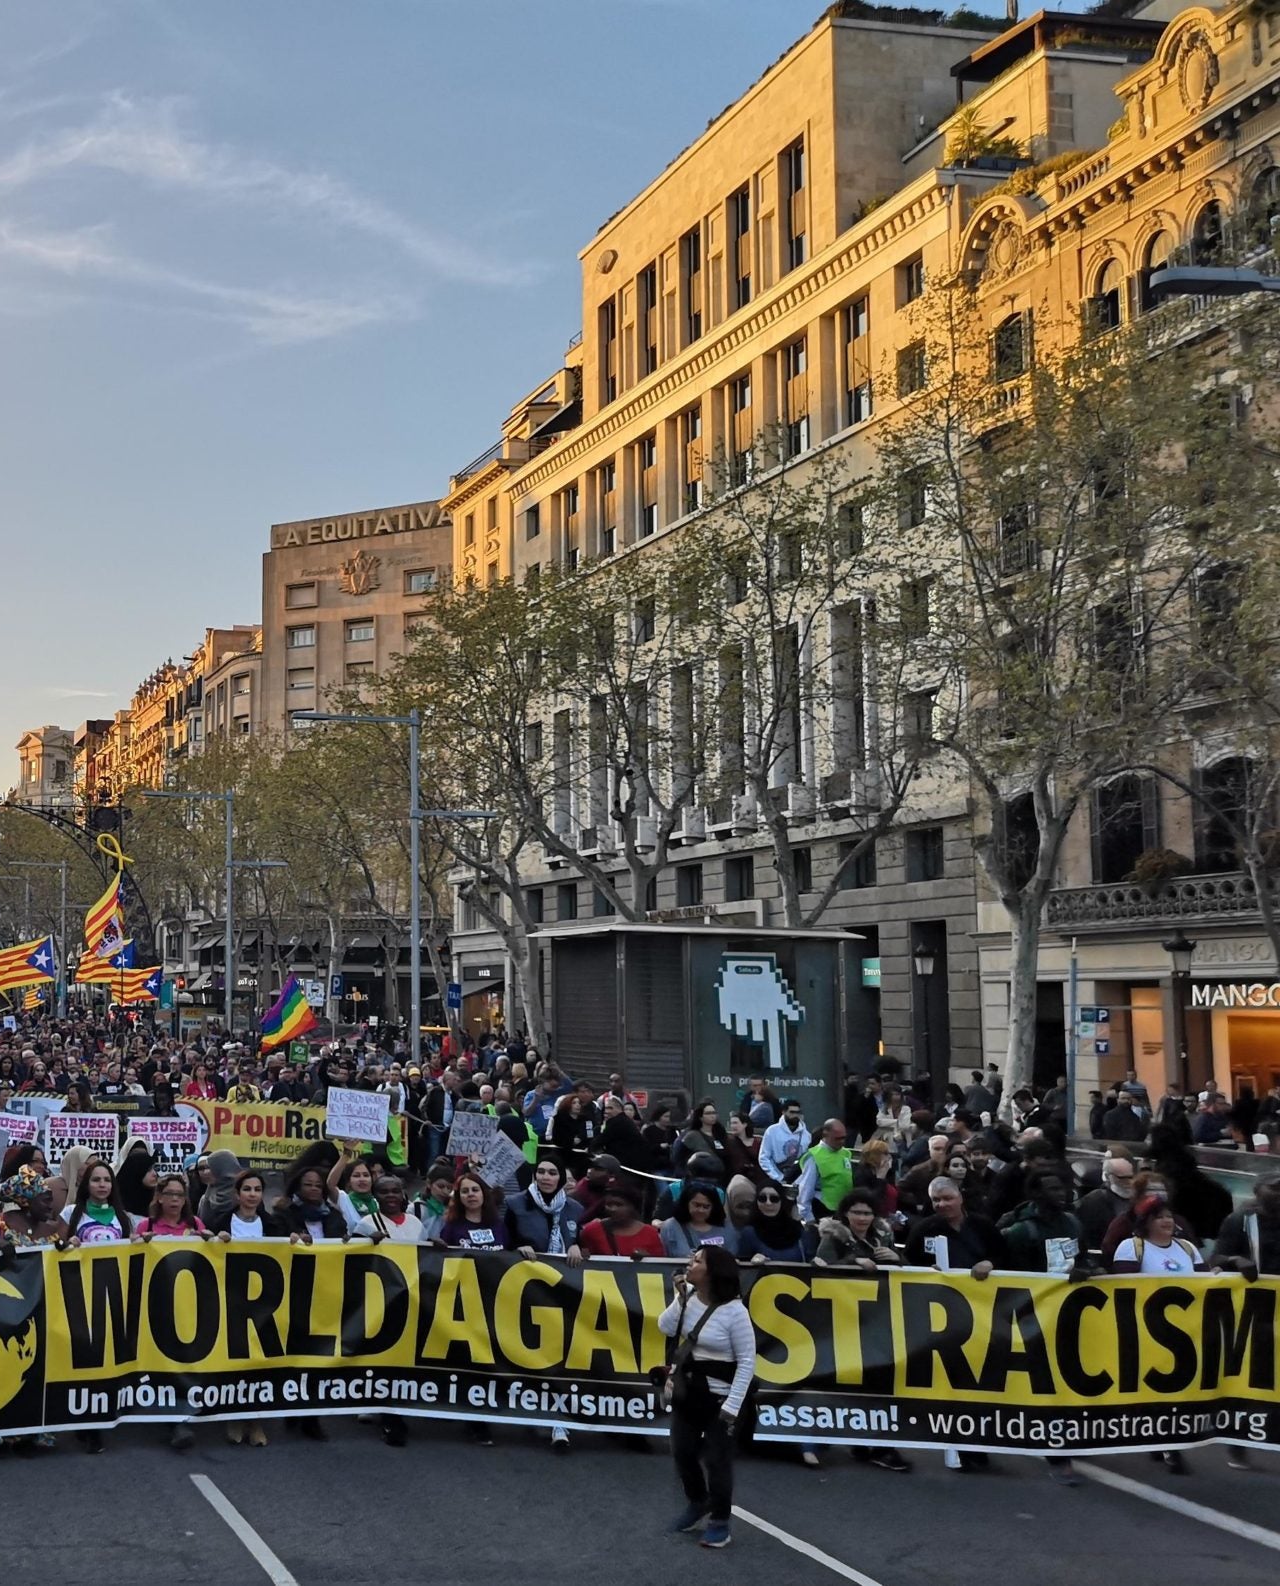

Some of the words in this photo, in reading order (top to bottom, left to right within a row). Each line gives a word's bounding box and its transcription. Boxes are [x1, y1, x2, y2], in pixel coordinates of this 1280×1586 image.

[308, 509, 453, 544] EQUITATIVA
[1099, 1010, 1108, 1021] P
[708, 1074, 719, 1084] La
[792, 1077, 818, 1088] arriba
[50, 1117, 66, 1128] ES
[69, 1118, 116, 1129] BUSCA
[132, 1122, 148, 1133] ES
[150, 1122, 197, 1133] BUSCA
[50, 1129, 68, 1137] PER
[70, 1130, 115, 1138] RACISME
[151, 1133, 197, 1141] RACISME
[50, 1138, 114, 1150] MARINE
[59, 1249, 409, 1370] WORLD
[421, 1257, 879, 1385] AGAIST
[901, 1280, 1276, 1397] RACISM
[68, 1386, 109, 1416] Un
[117, 1375, 176, 1410] món
[188, 1377, 274, 1409] contra
[283, 1372, 309, 1401] el
[318, 1371, 439, 1403] racisme
[449, 1374, 458, 1404] i
[468, 1378, 497, 1408] el
[507, 1382, 655, 1420] feixisme!
[758, 1403, 899, 1431] assaran!
